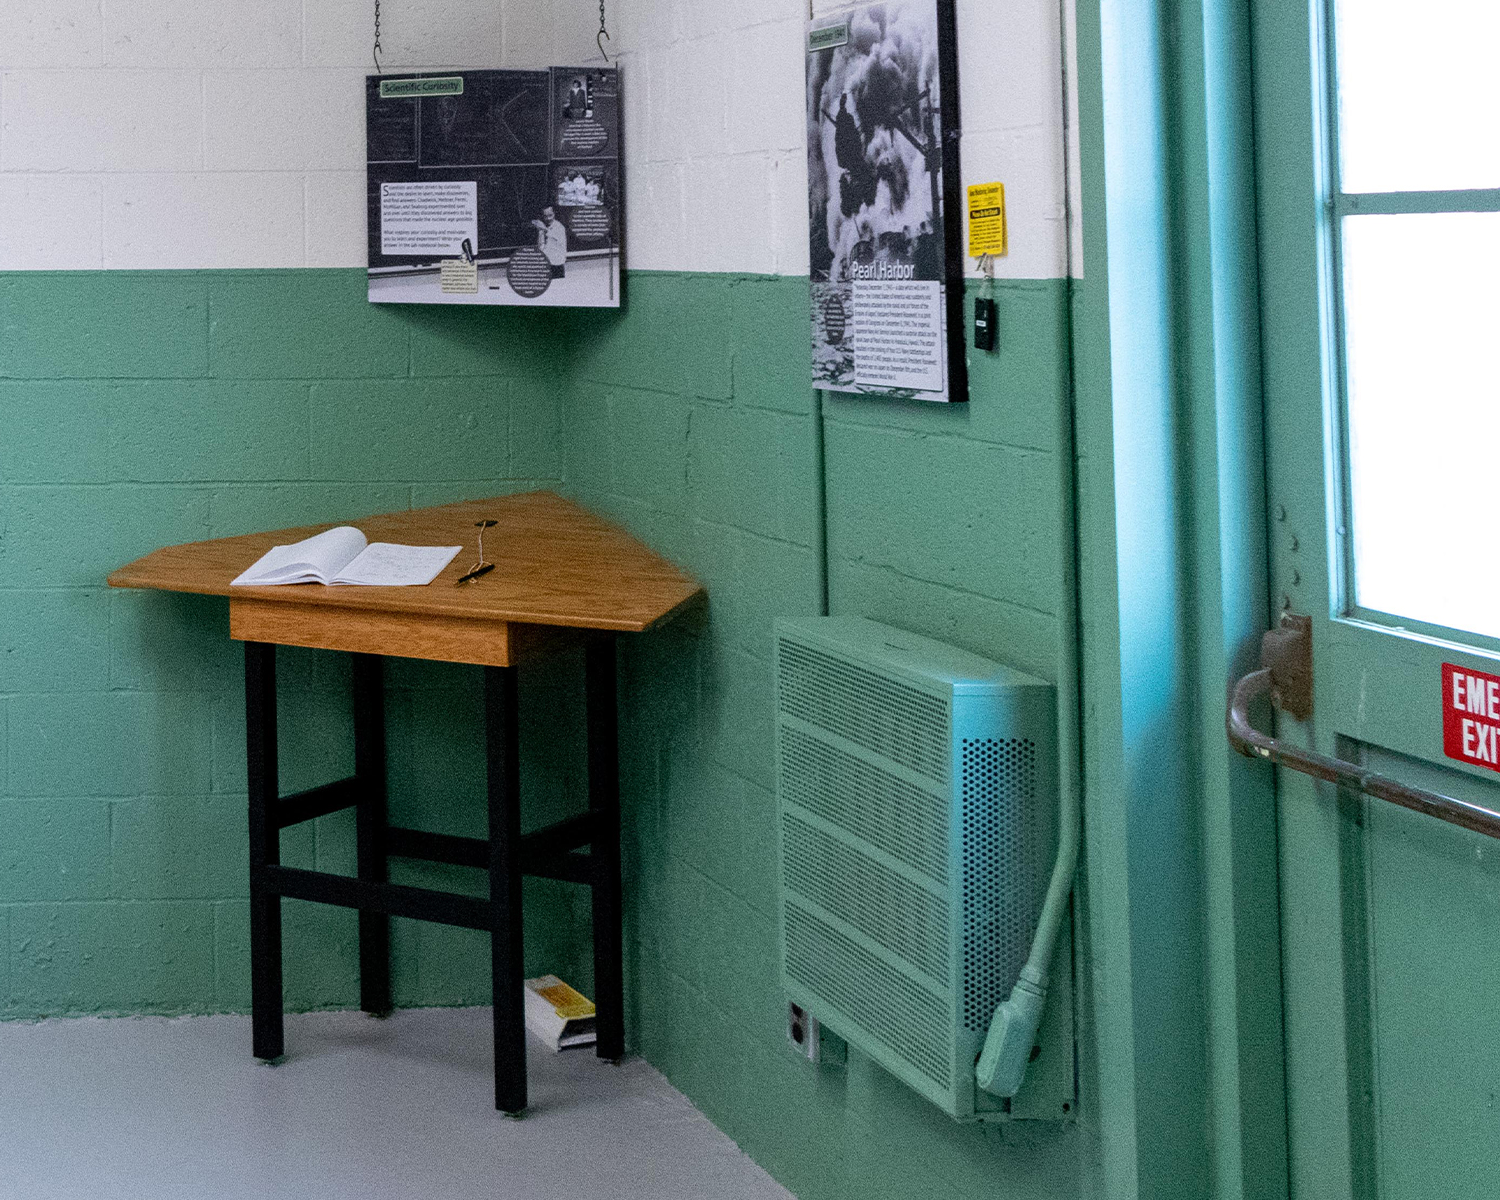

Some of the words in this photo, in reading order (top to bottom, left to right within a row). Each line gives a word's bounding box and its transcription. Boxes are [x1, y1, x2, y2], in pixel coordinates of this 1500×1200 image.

[385, 83, 420, 92] Scientific
[423, 81, 459, 91] Curiosity
[852, 260, 877, 279] Pearl
[879, 259, 915, 280] Harbor
